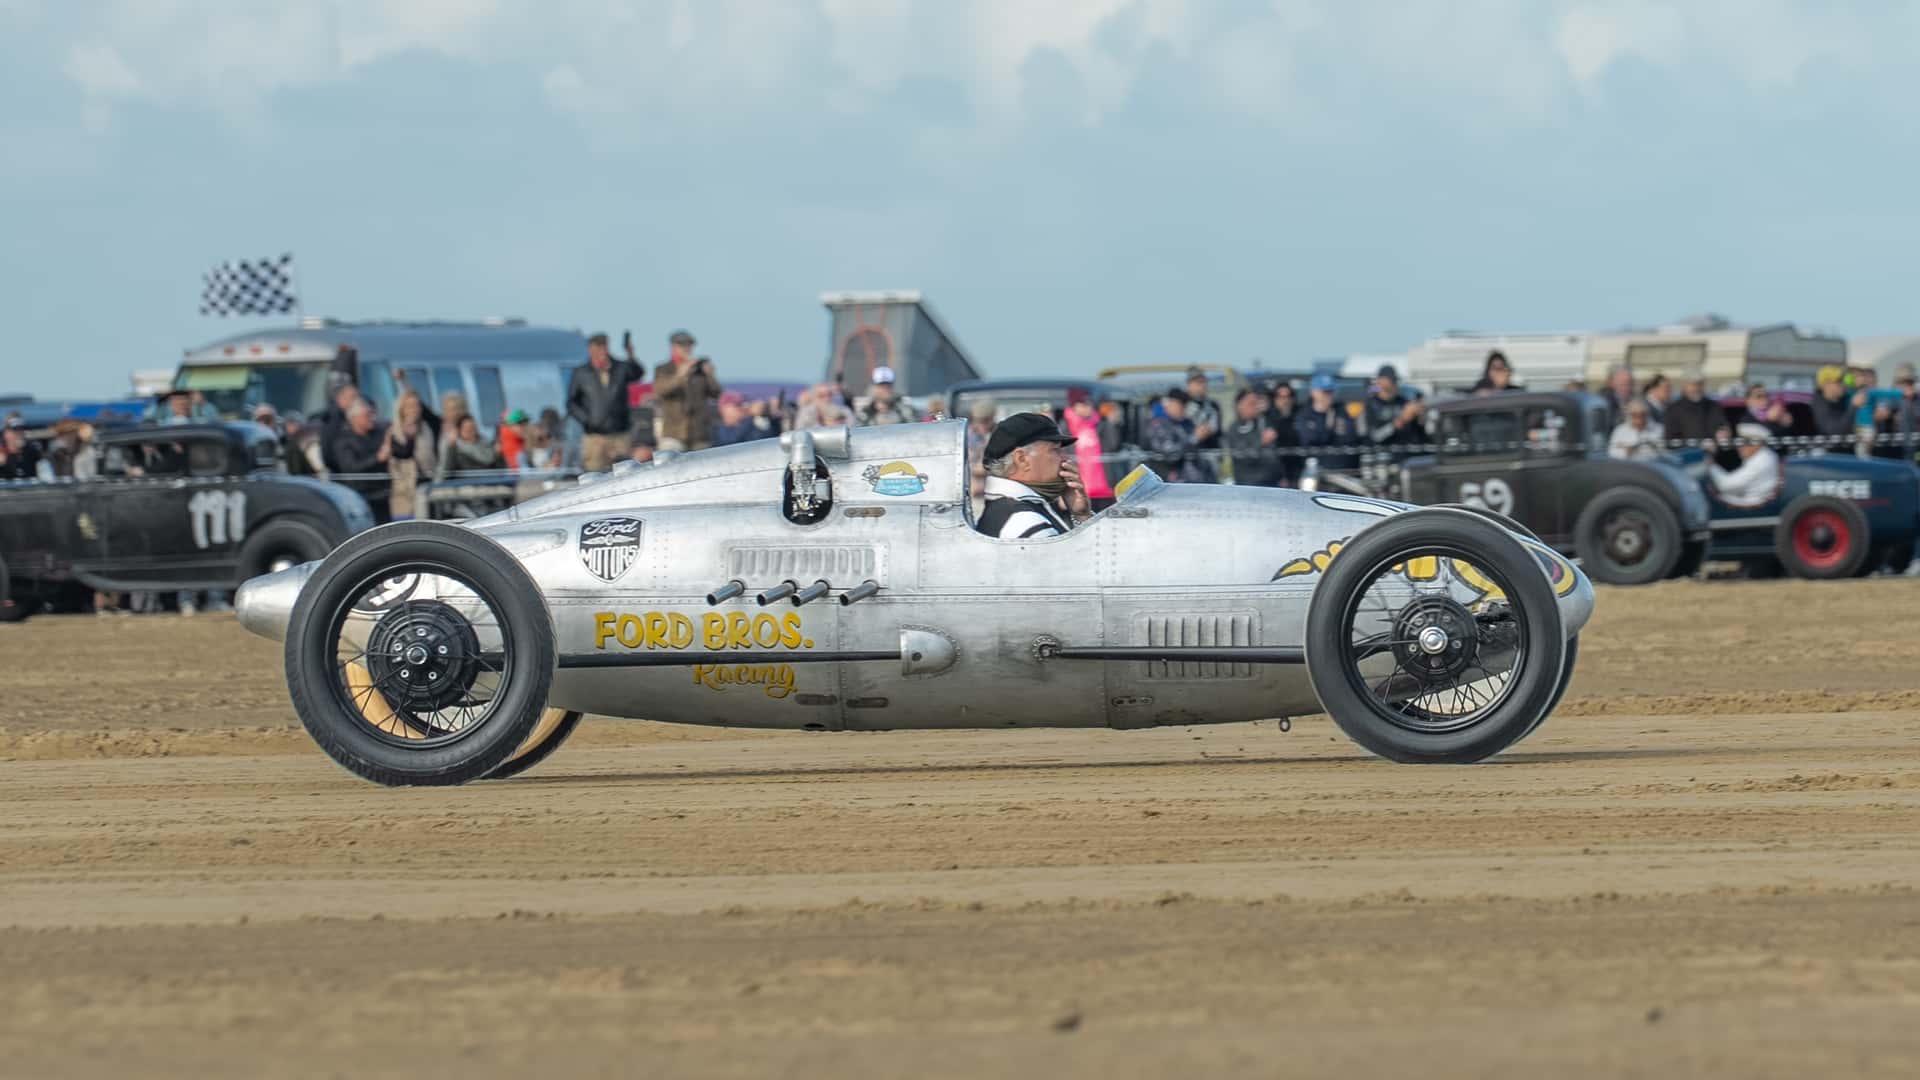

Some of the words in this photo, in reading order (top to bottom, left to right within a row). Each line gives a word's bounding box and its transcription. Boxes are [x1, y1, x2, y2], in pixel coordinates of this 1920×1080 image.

[584, 519, 639, 535] Ford
[580, 545, 640, 579] MOTORS
[593, 611, 693, 649] FORD
[702, 611, 815, 650] BROS.
[694, 663, 798, 699] Racing
